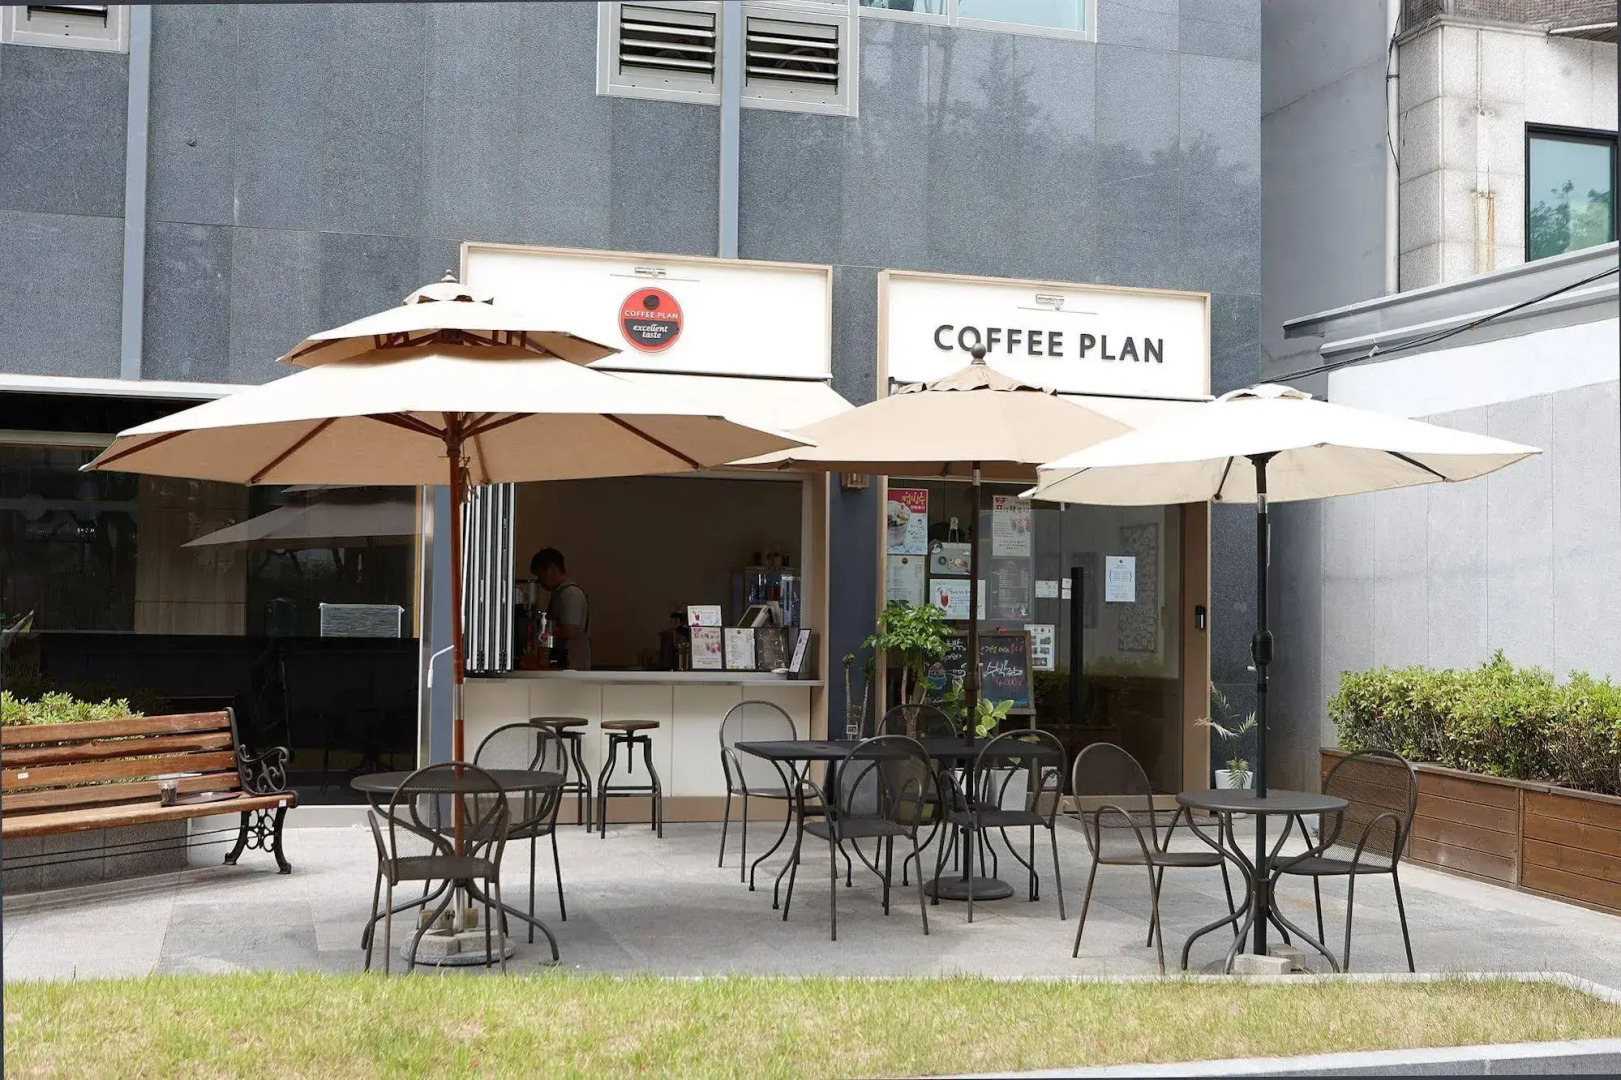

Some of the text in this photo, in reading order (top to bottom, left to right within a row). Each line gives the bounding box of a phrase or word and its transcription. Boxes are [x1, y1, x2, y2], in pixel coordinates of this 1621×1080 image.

[624, 310, 655, 318] COFFEE
[633, 323, 668, 332] excellent
[933, 324, 1163, 363] COFFEE PLAN
